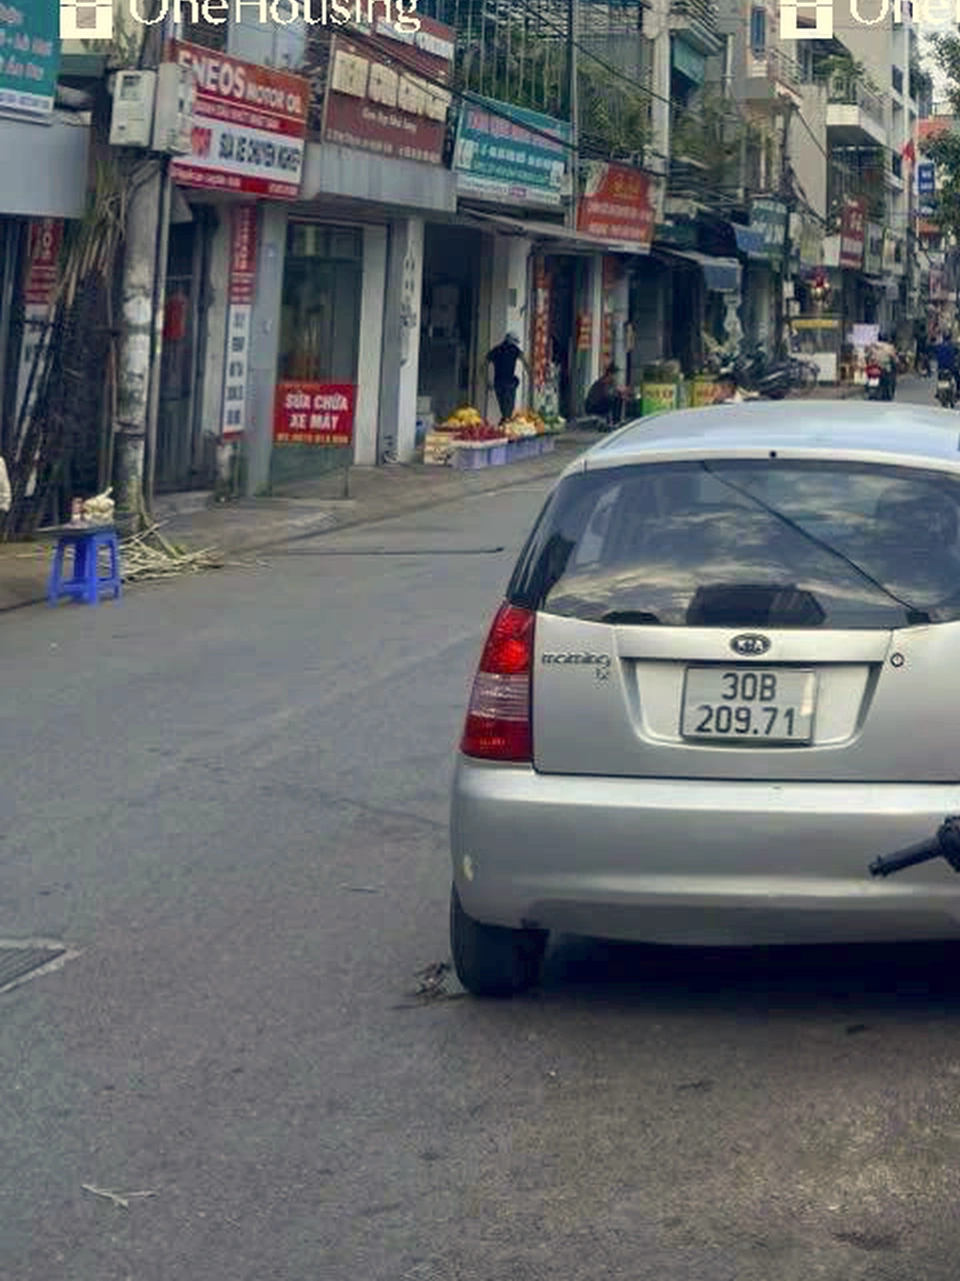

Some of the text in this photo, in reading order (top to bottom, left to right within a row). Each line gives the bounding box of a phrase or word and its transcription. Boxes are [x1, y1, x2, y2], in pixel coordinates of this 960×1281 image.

[289, 413, 307, 431] XE
[722, 672, 777, 701] 30B
[694, 704, 795, 736] 209.71
